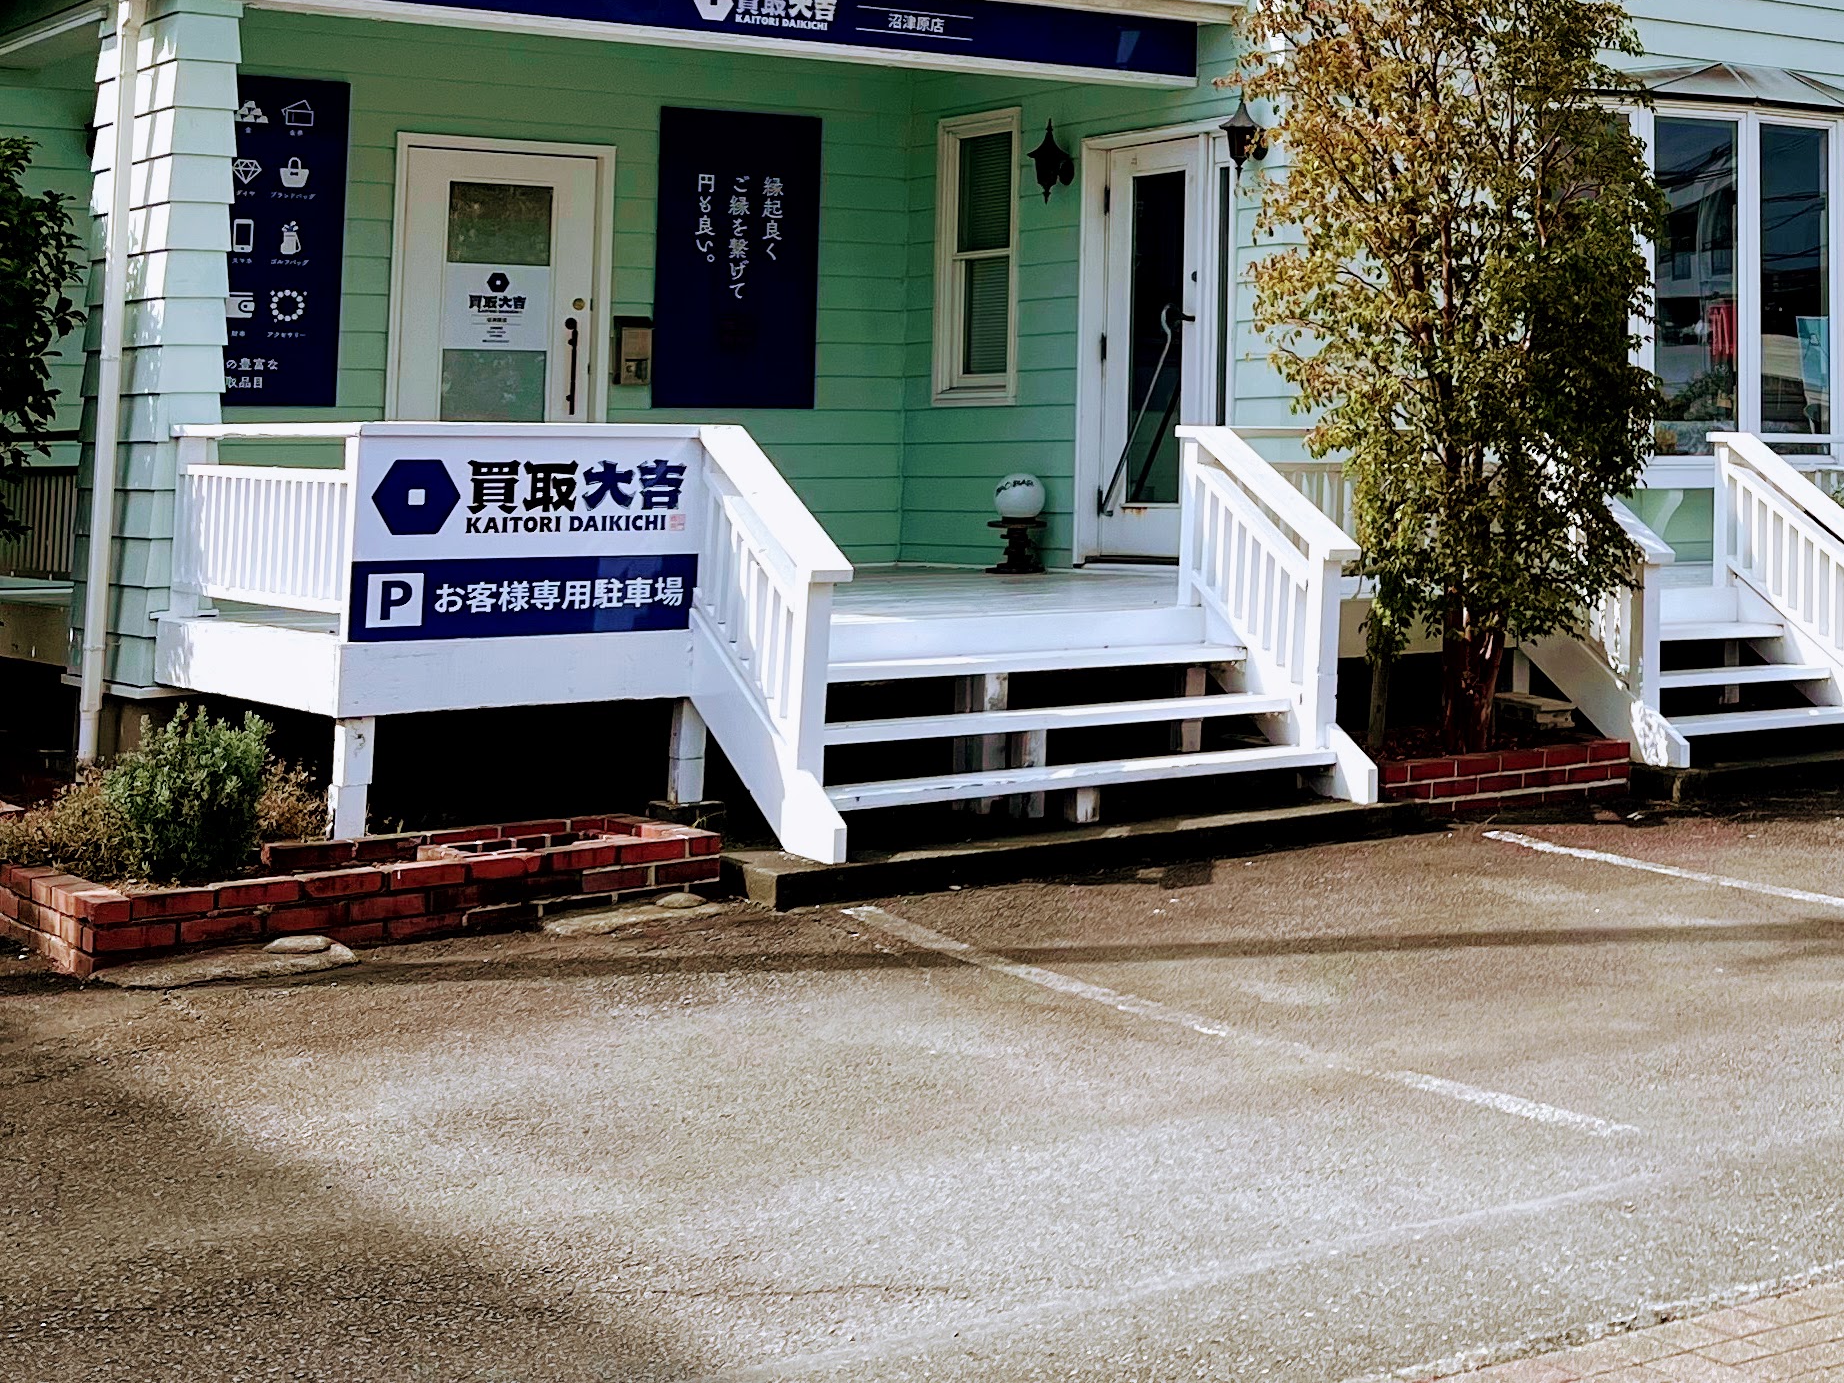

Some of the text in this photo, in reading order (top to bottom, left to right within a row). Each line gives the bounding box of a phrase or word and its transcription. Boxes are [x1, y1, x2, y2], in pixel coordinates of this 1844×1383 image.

[735, 14, 828, 31] KAITORI DAIKICHI
[888, 13, 945, 33] 沼津原店
[728, 175, 750, 299] ご縁を繋げて
[761, 176, 784, 260] 縁起良く
[466, 458, 687, 515] 買取大吉
[465, 515, 561, 534] KAITORI
[568, 514, 666, 533] DAIKICHI
[379, 576, 685, 621] P お客様専用駐車場
